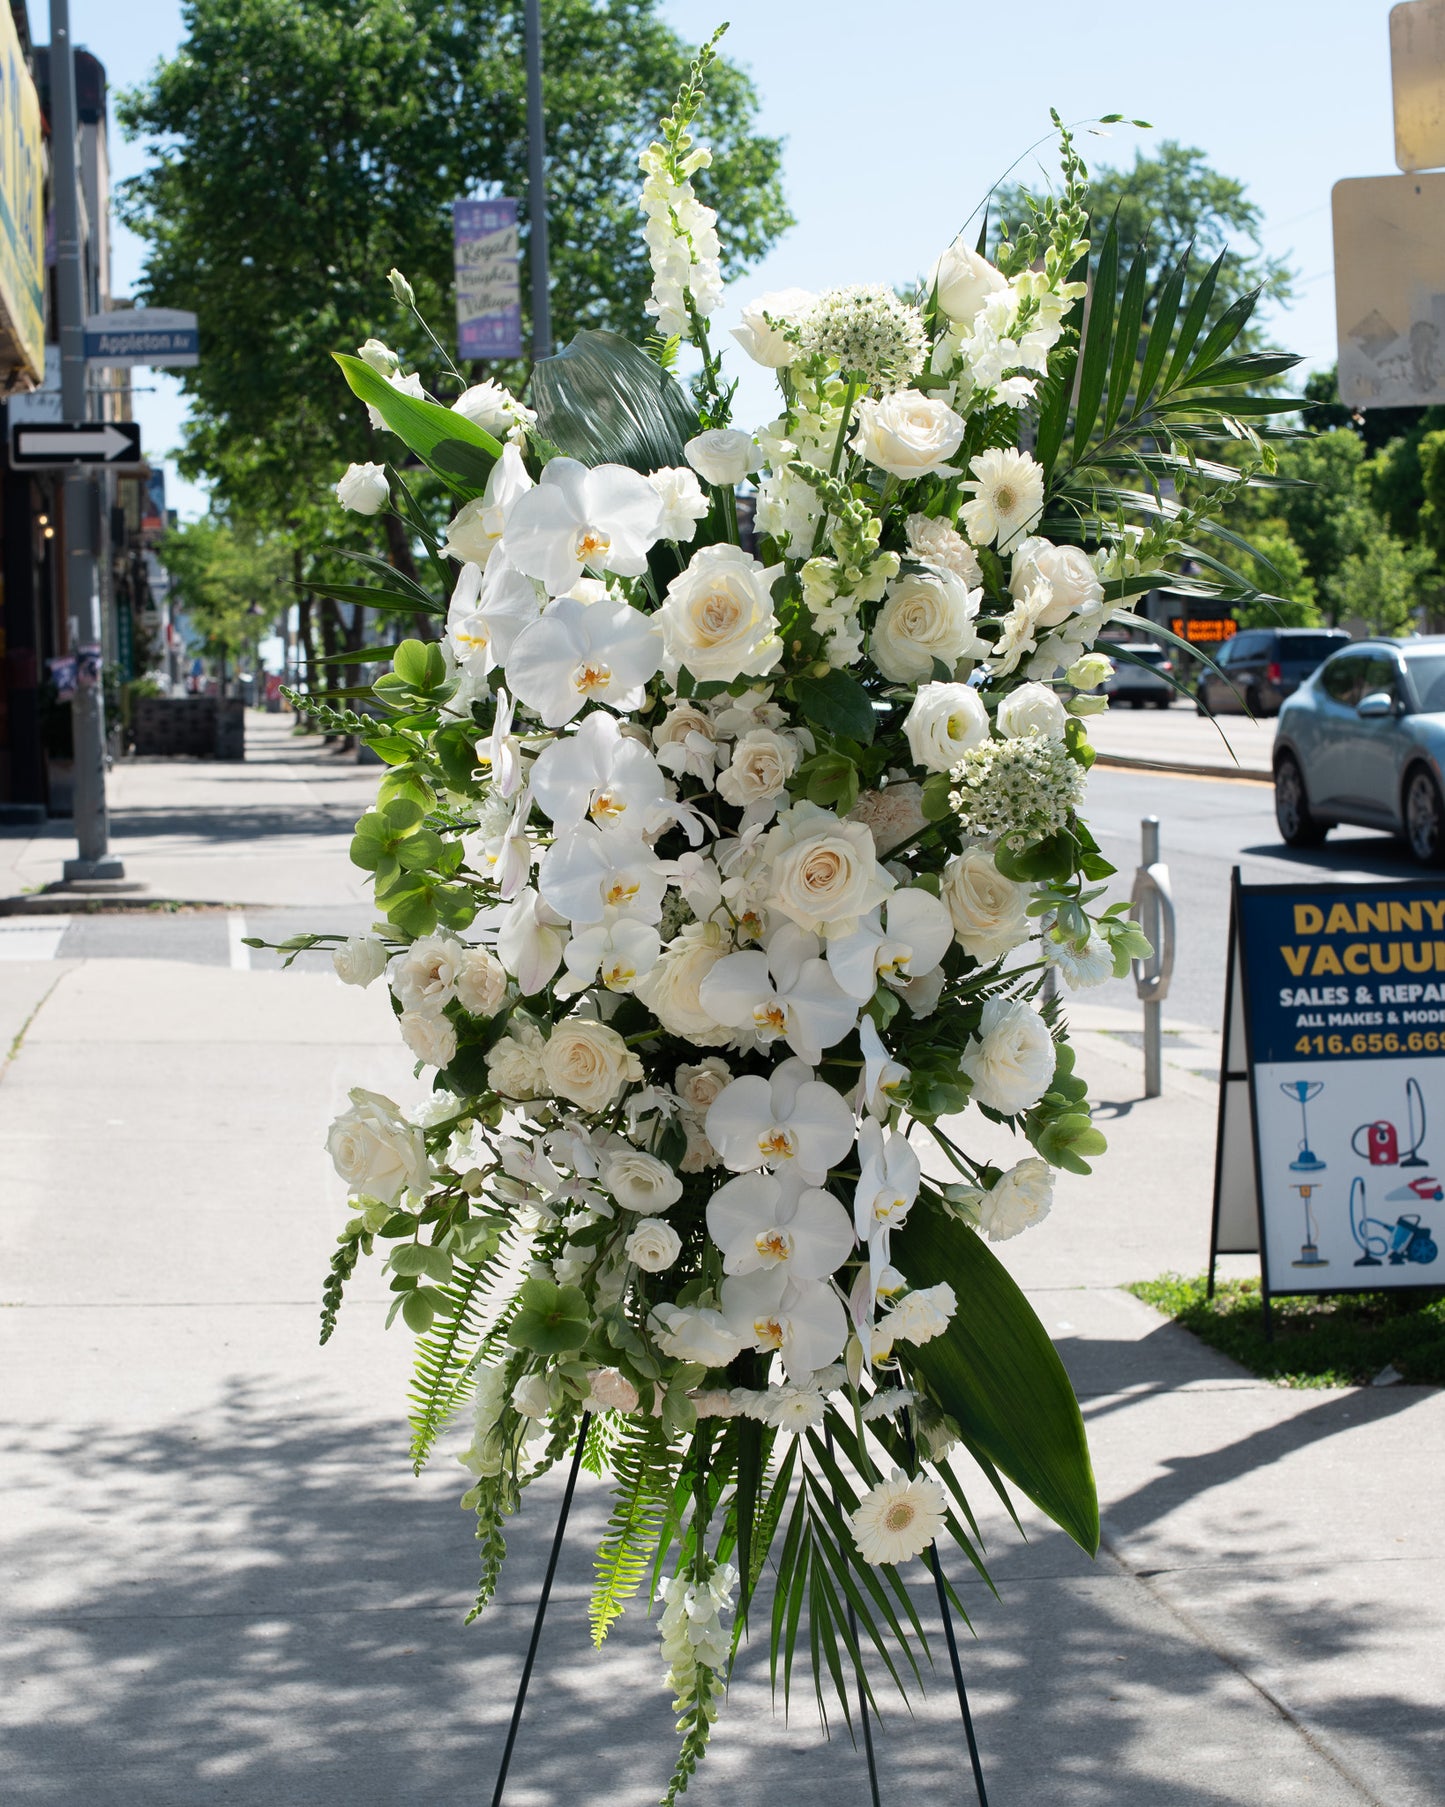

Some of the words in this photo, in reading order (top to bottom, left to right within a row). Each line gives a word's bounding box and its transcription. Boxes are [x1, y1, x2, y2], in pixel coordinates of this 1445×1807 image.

[99, 332, 170, 354] Appleton
[1172, 619, 1223, 631] Wlcome
[1293, 900, 1445, 935] DANNY
[1279, 986, 1349, 1007] SALES
[1355, 986, 1374, 1005] &
[1296, 1013, 1325, 1027] ALL
[1328, 1011, 1383, 1026] MAKES
[1387, 1010, 1399, 1025] &
